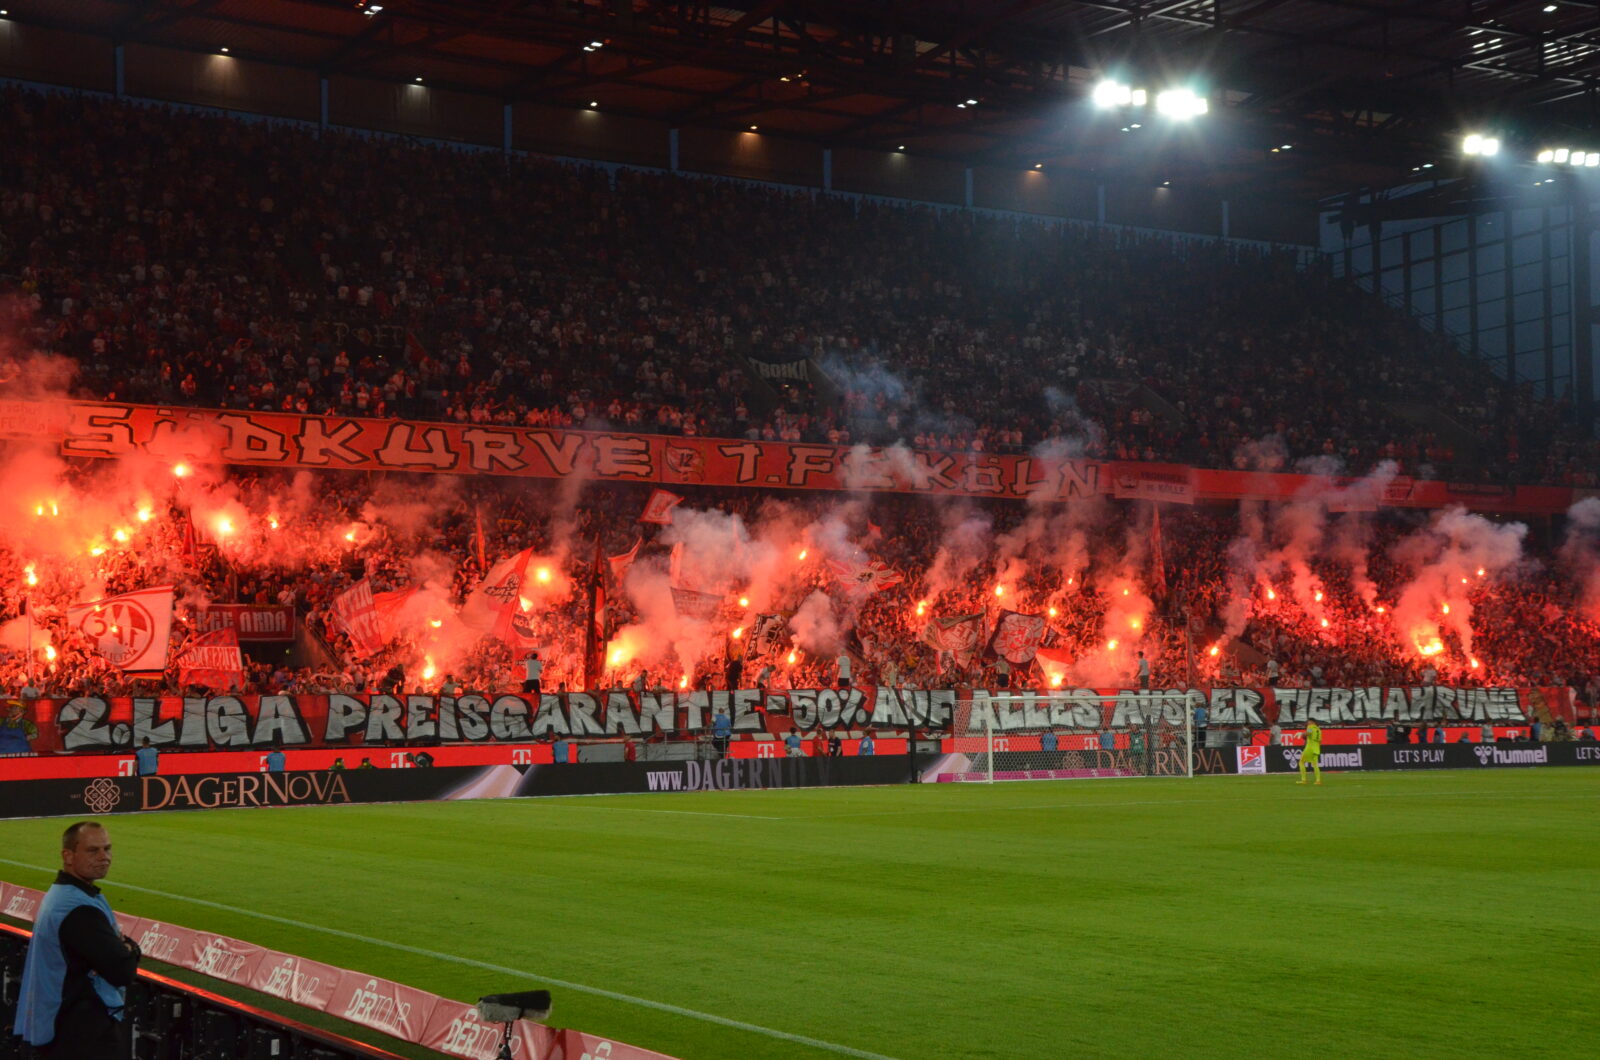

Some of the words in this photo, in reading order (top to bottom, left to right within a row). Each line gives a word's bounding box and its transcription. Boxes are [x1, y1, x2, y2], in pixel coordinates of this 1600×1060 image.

[64, 403, 653, 478] SÜDKURVE
[911, 449, 1099, 498] KÖLN
[188, 610, 235, 633] REE
[871, 686, 956, 729] AUF
[966, 688, 1101, 731] ALLES
[1272, 686, 1527, 724] TIERNAHRUNG
[1097, 749, 1227, 775] DARNOVA
[1304, 748, 1363, 767] ummel
[1393, 749, 1420, 763] LET'S
[1422, 748, 1445, 763] PLAY
[1493, 745, 1548, 764] hummel
